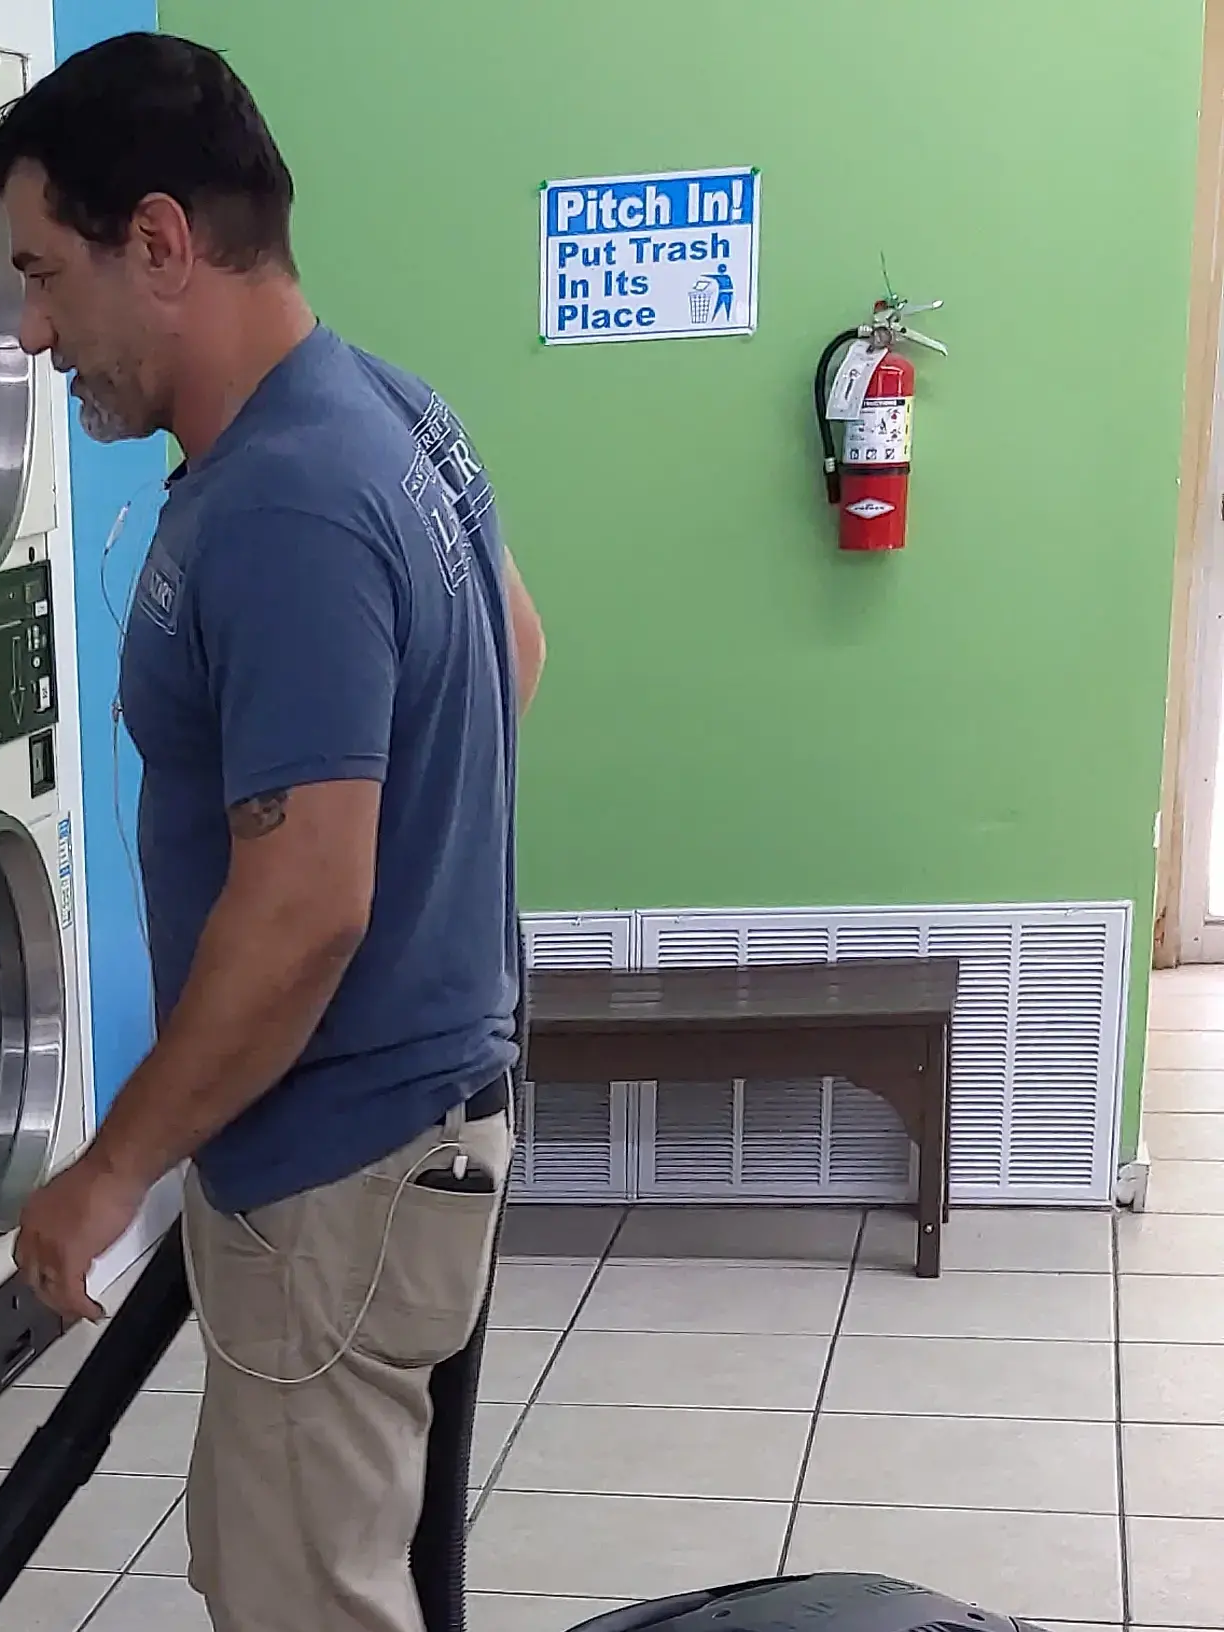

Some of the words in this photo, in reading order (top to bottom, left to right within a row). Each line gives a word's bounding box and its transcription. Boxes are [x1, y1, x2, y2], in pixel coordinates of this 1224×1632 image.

[556, 185, 670, 232] Pitch
[687, 181, 744, 223] In!
[558, 239, 616, 269] Put
[629, 233, 730, 263] Trash
[558, 274, 589, 299] In
[604, 271, 649, 296] Its
[558, 303, 656, 331] Place
